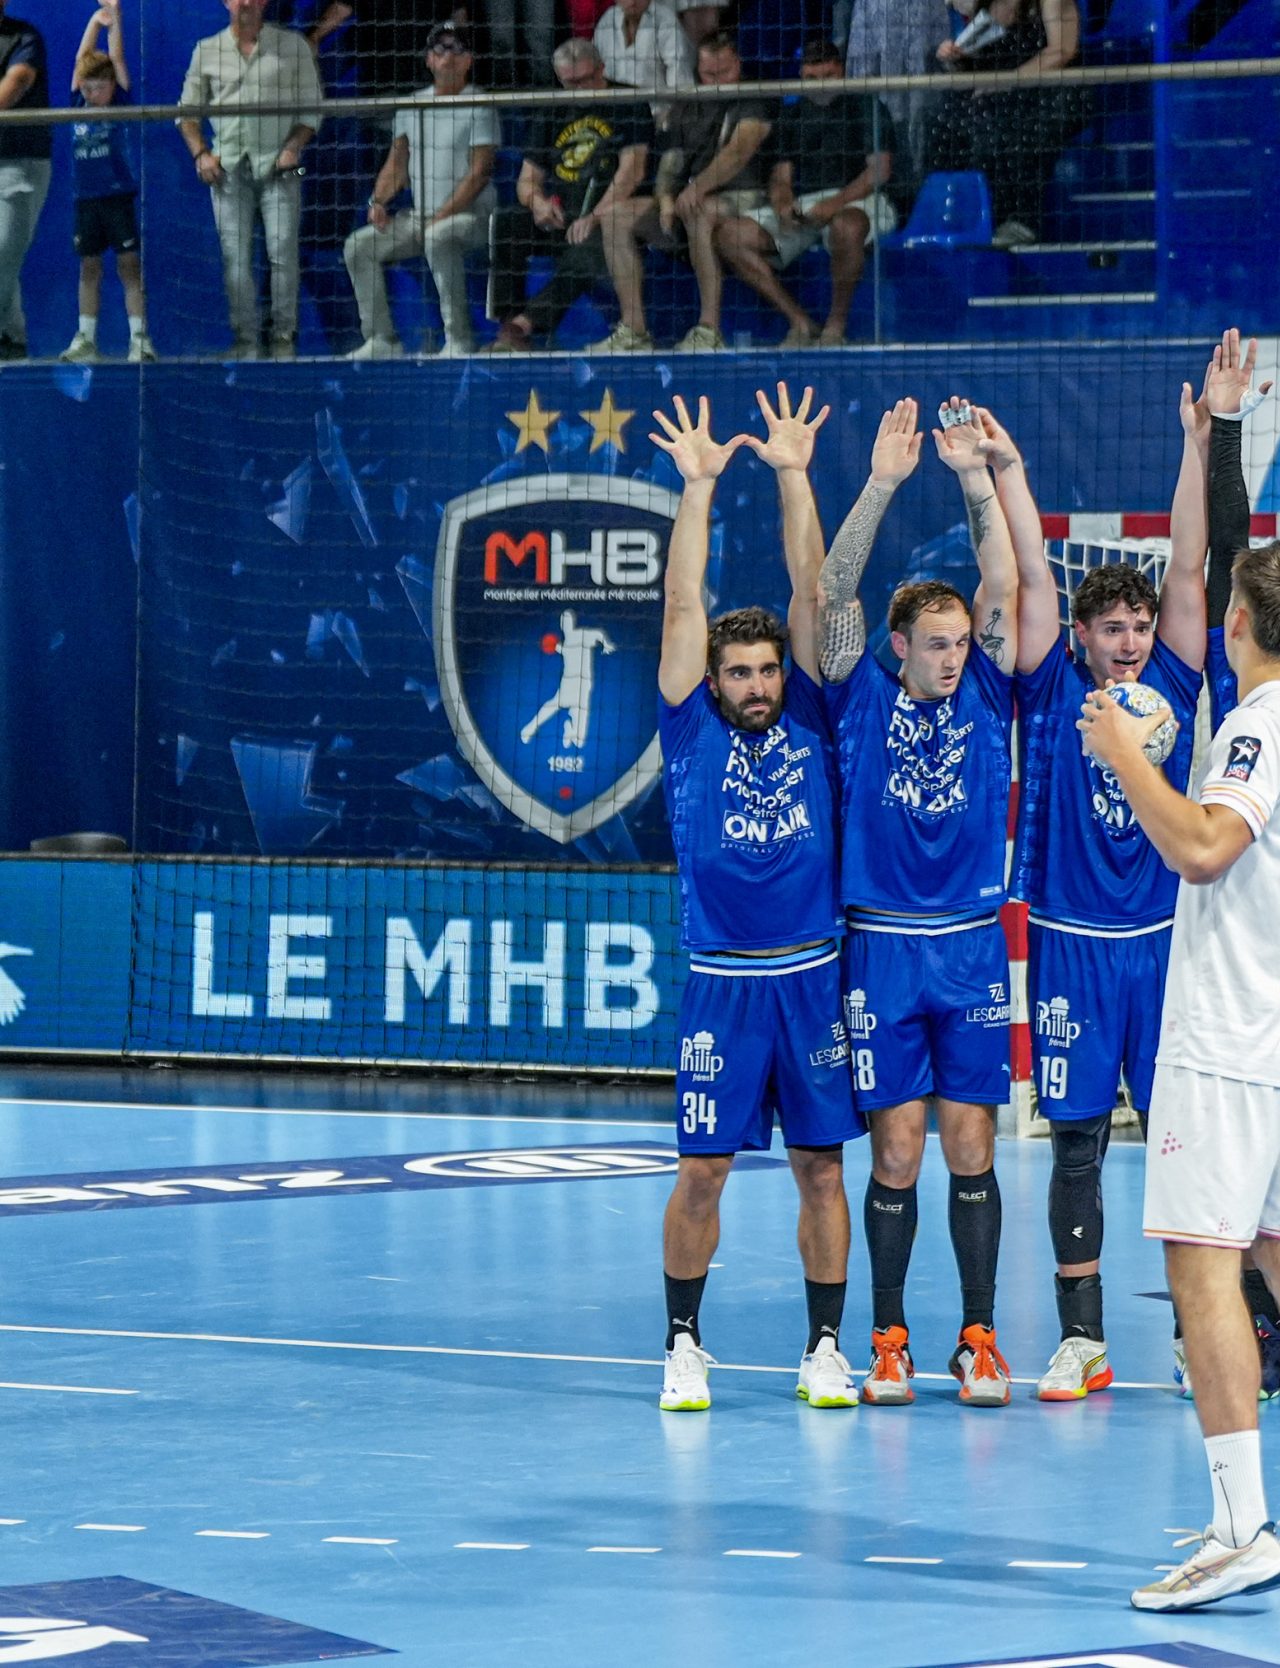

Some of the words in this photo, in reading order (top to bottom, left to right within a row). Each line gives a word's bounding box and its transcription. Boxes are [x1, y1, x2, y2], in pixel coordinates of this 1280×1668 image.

[484, 530, 660, 586] MHB
[547, 755, 584, 772] 1982
[725, 815, 767, 843] ON
[772, 803, 810, 840] AIR
[192, 912, 332, 1019] LE
[385, 917, 660, 1029] MHB
[1036, 1001, 1081, 1048] Philip
[680, 1037, 724, 1082] Philip
[1040, 1056, 1068, 1099] 19
[682, 1091, 717, 1135] 34
